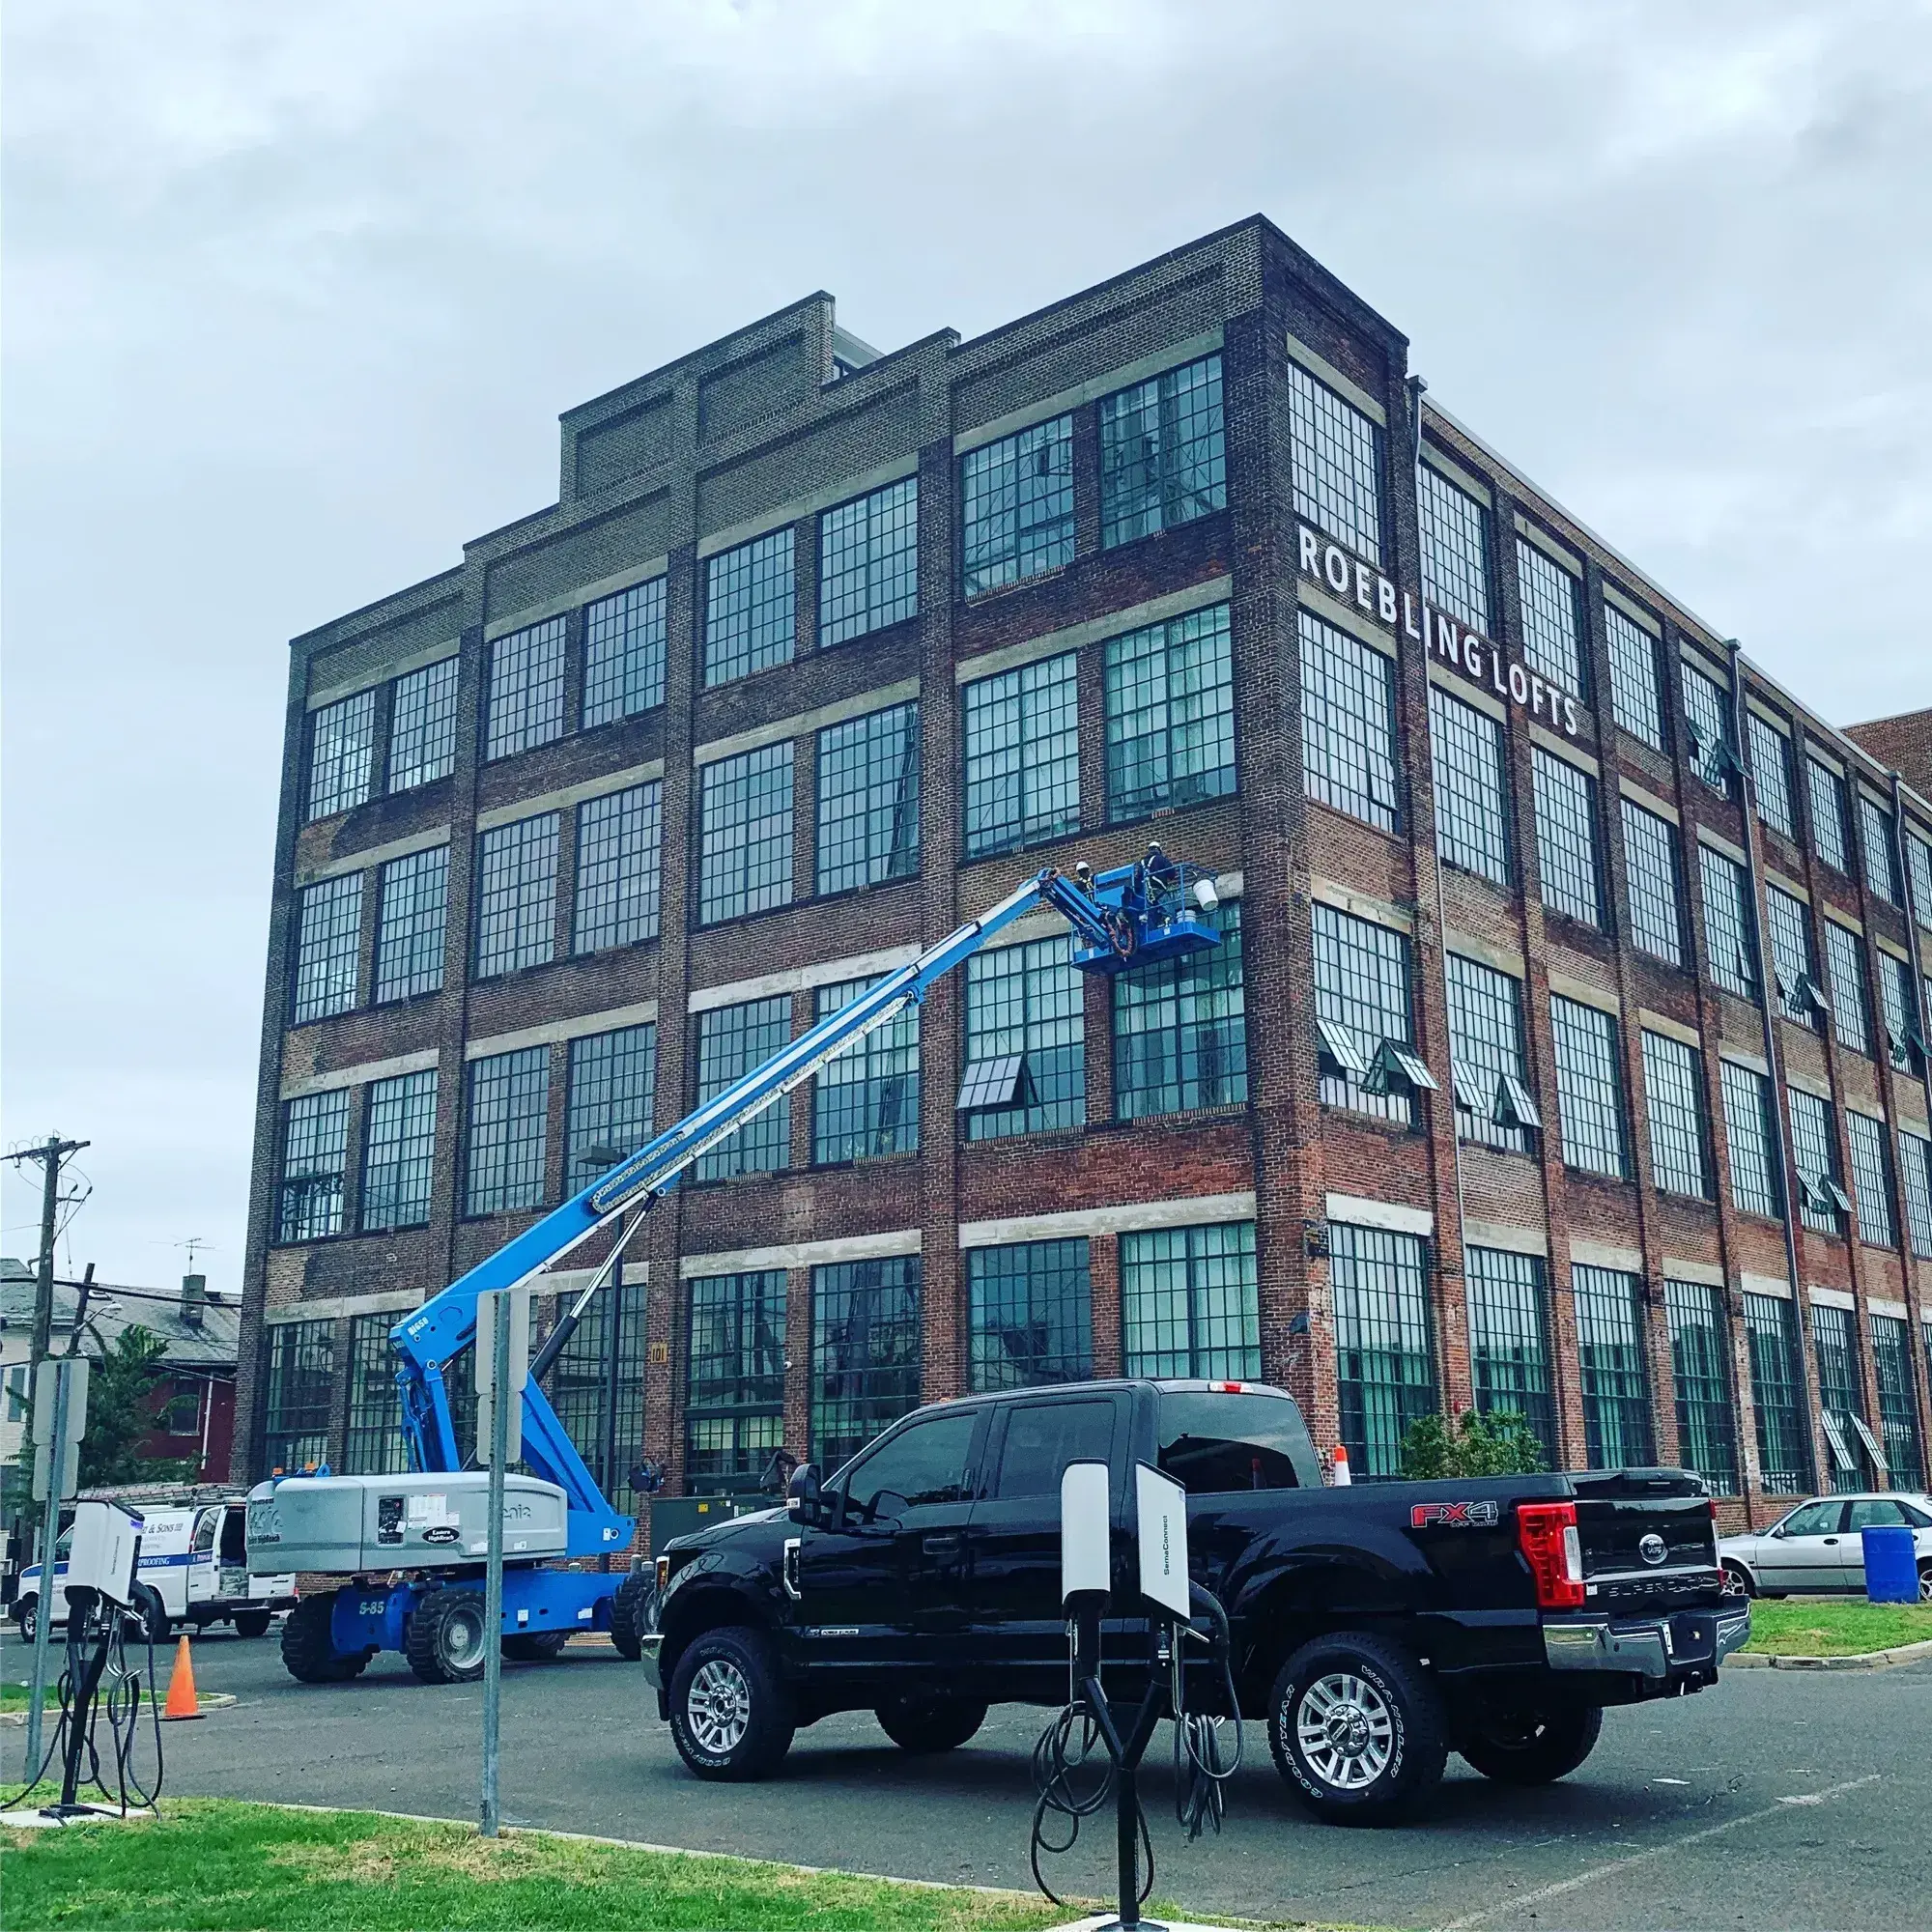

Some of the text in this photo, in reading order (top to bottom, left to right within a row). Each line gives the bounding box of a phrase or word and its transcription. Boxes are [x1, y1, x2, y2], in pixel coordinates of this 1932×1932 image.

[1299, 525, 1577, 736] ROEBLING LOFTS
[1411, 1501, 1498, 1527] FX4
[359, 1602, 384, 1614] S-85
[1279, 1684, 1323, 1799] GOODYEAR
[1361, 1664, 1405, 1778] WRANGLER
